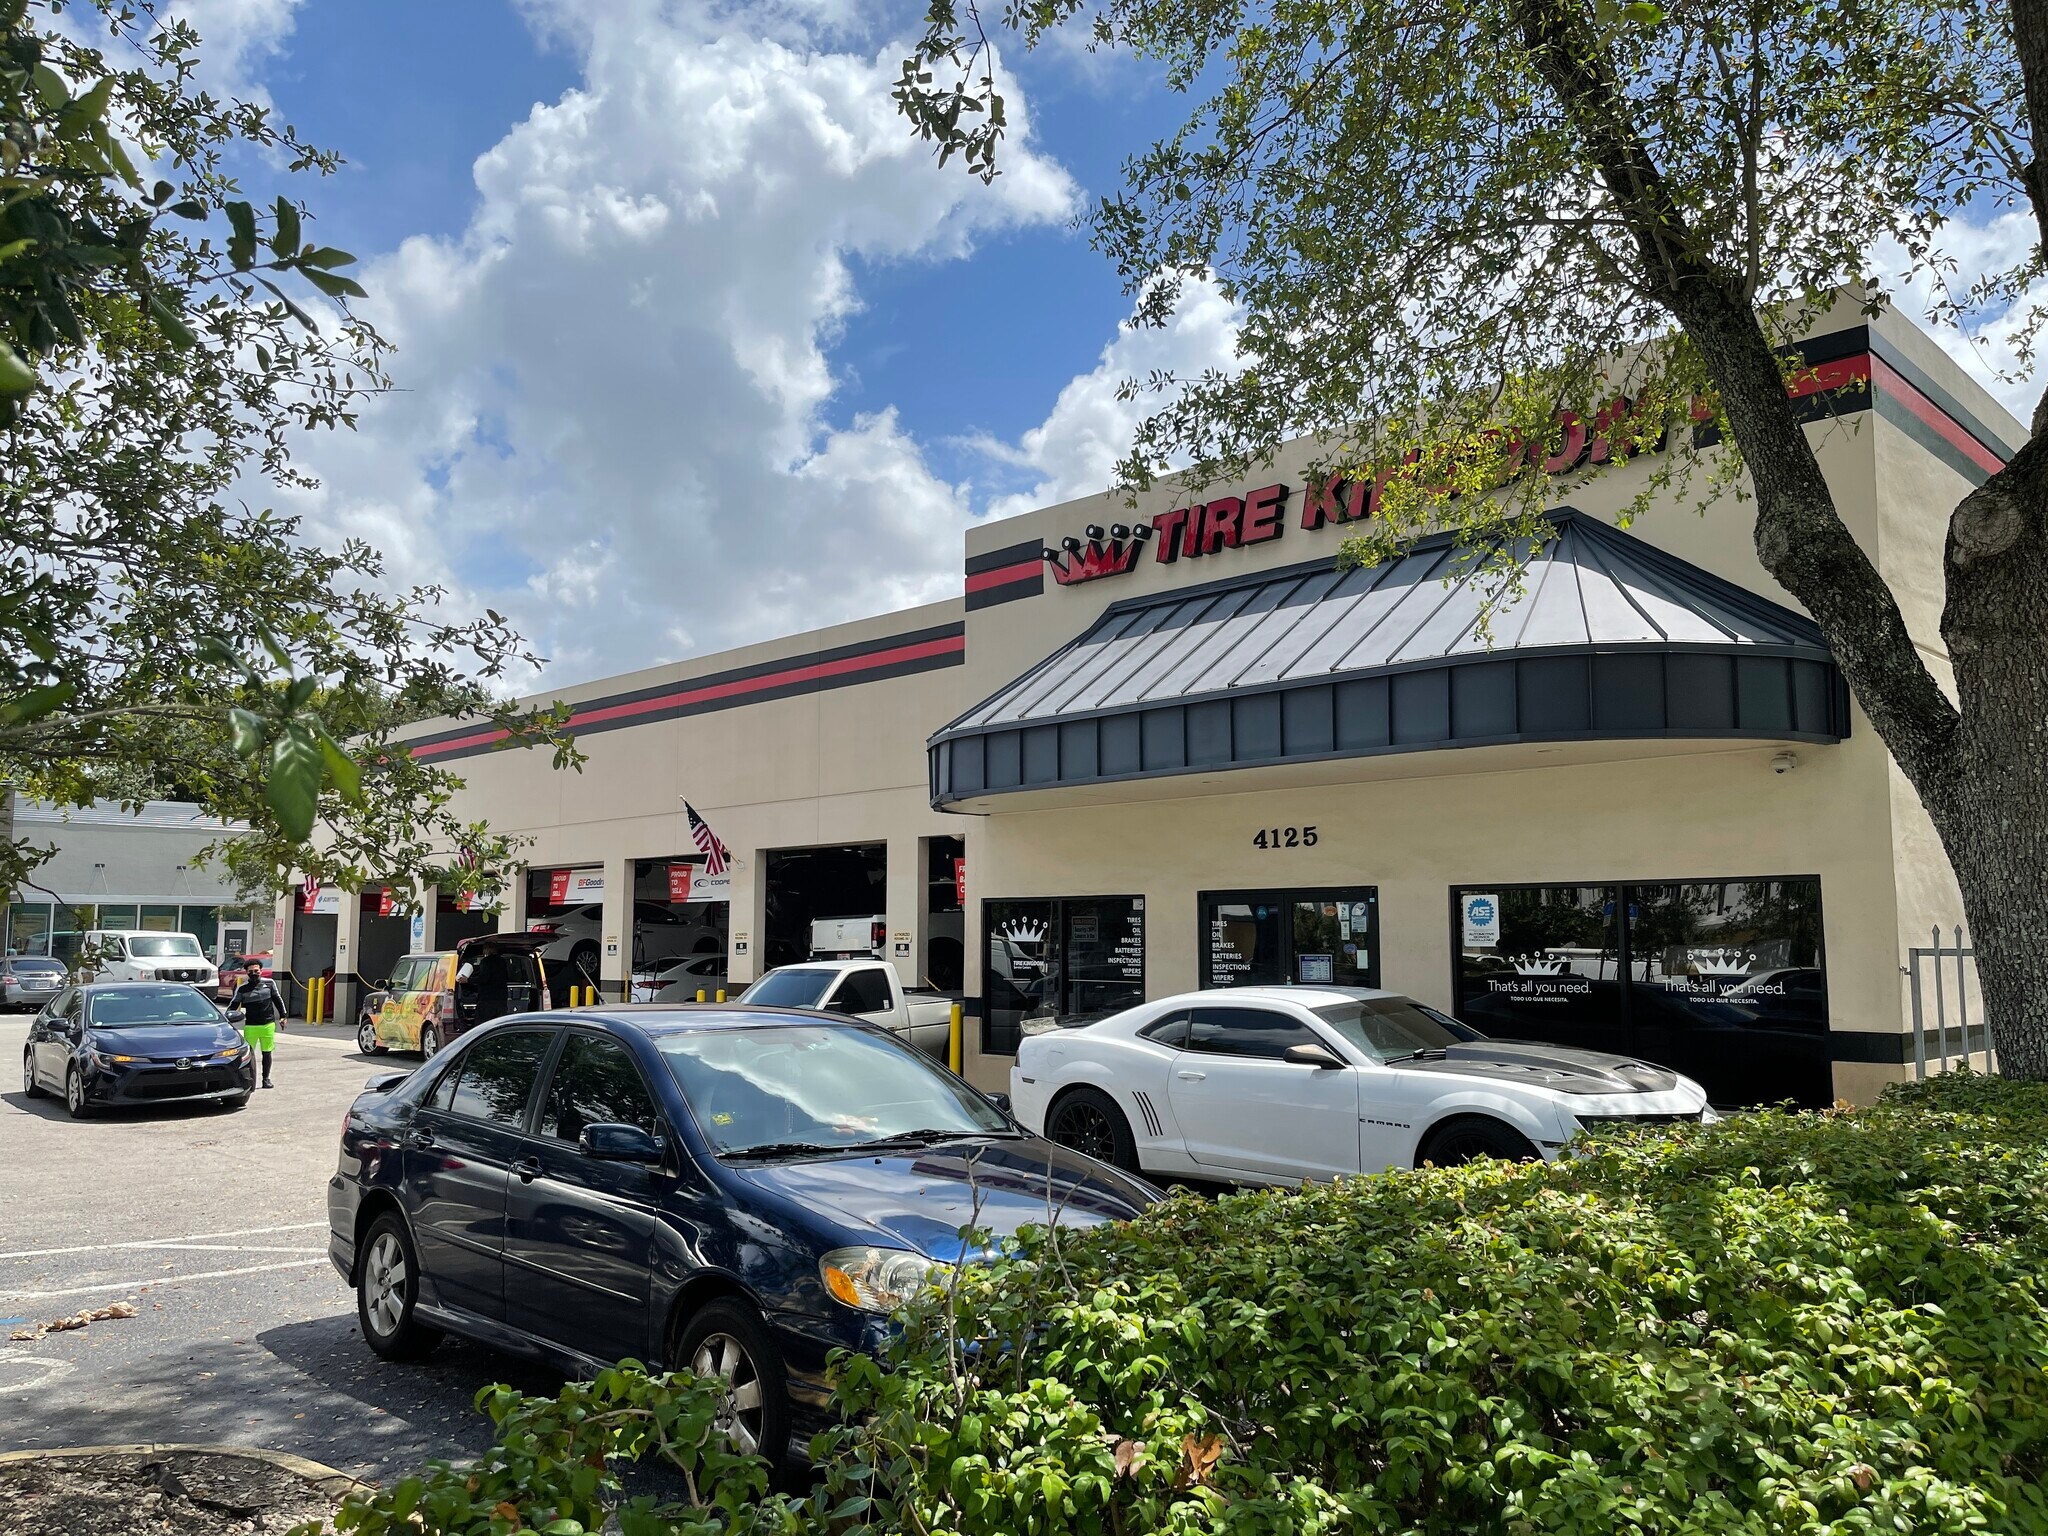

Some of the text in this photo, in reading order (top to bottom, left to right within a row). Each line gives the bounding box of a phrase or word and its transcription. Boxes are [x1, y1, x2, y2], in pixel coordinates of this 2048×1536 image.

[1152, 390, 1668, 564] TIRE KIDOM
[1253, 826, 1318, 849] 4125
[1470, 906, 1490, 916] ASE
[1488, 980, 1592, 996] That's all you need.
[1702, 980, 1716, 993] all
[1719, 984, 1744, 996] you
[1748, 981, 1786, 995] need.
[1360, 1119, 1410, 1128] CAMARO
